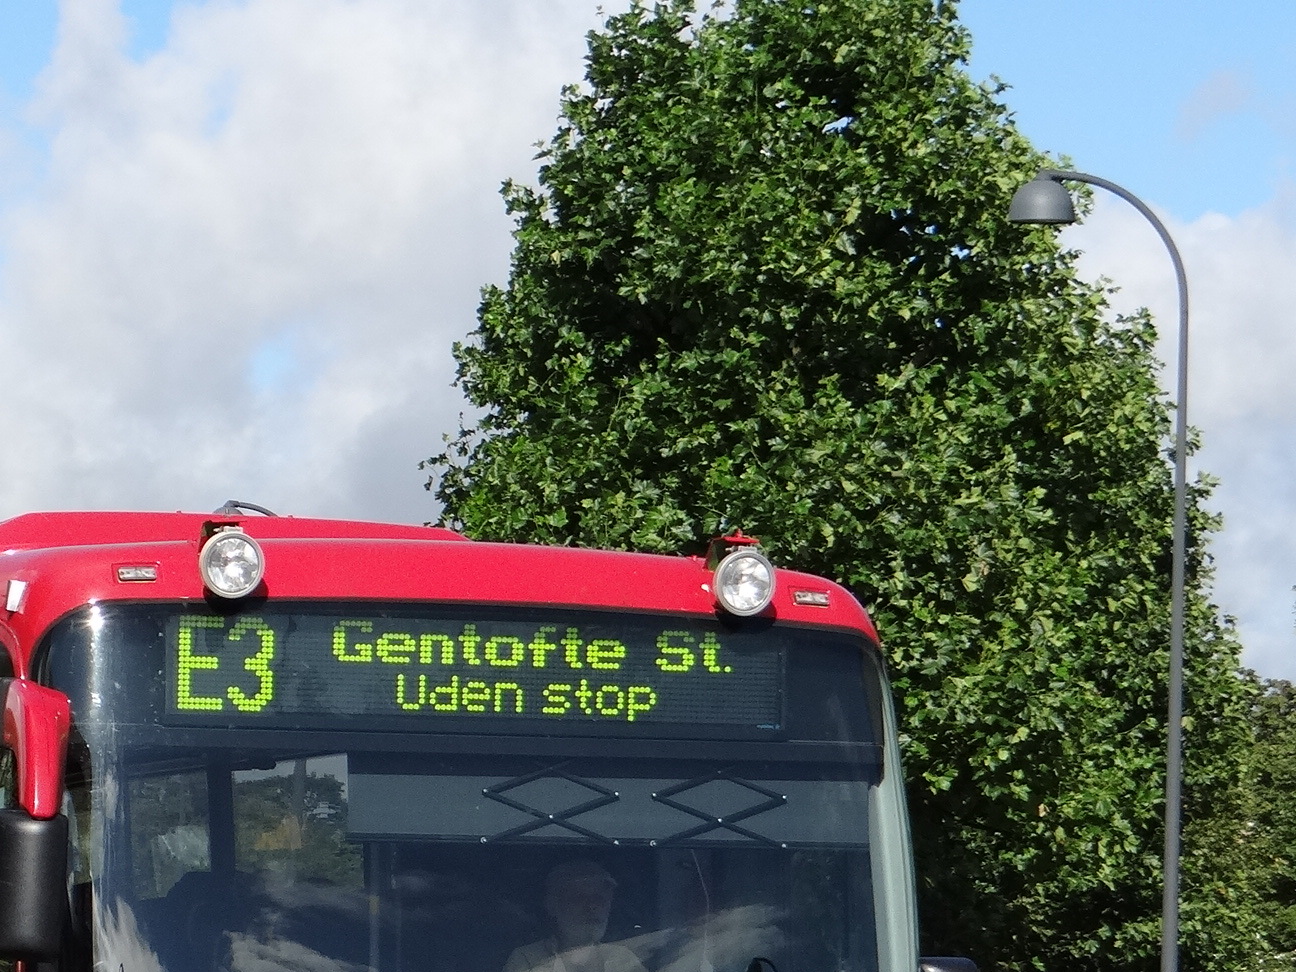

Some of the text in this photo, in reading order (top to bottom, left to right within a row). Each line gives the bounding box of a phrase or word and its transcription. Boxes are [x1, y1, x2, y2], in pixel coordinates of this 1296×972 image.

[177, 615, 274, 711] E3
[332, 619, 733, 674] Gentofte St.
[396, 673, 657, 722] Uden stop
